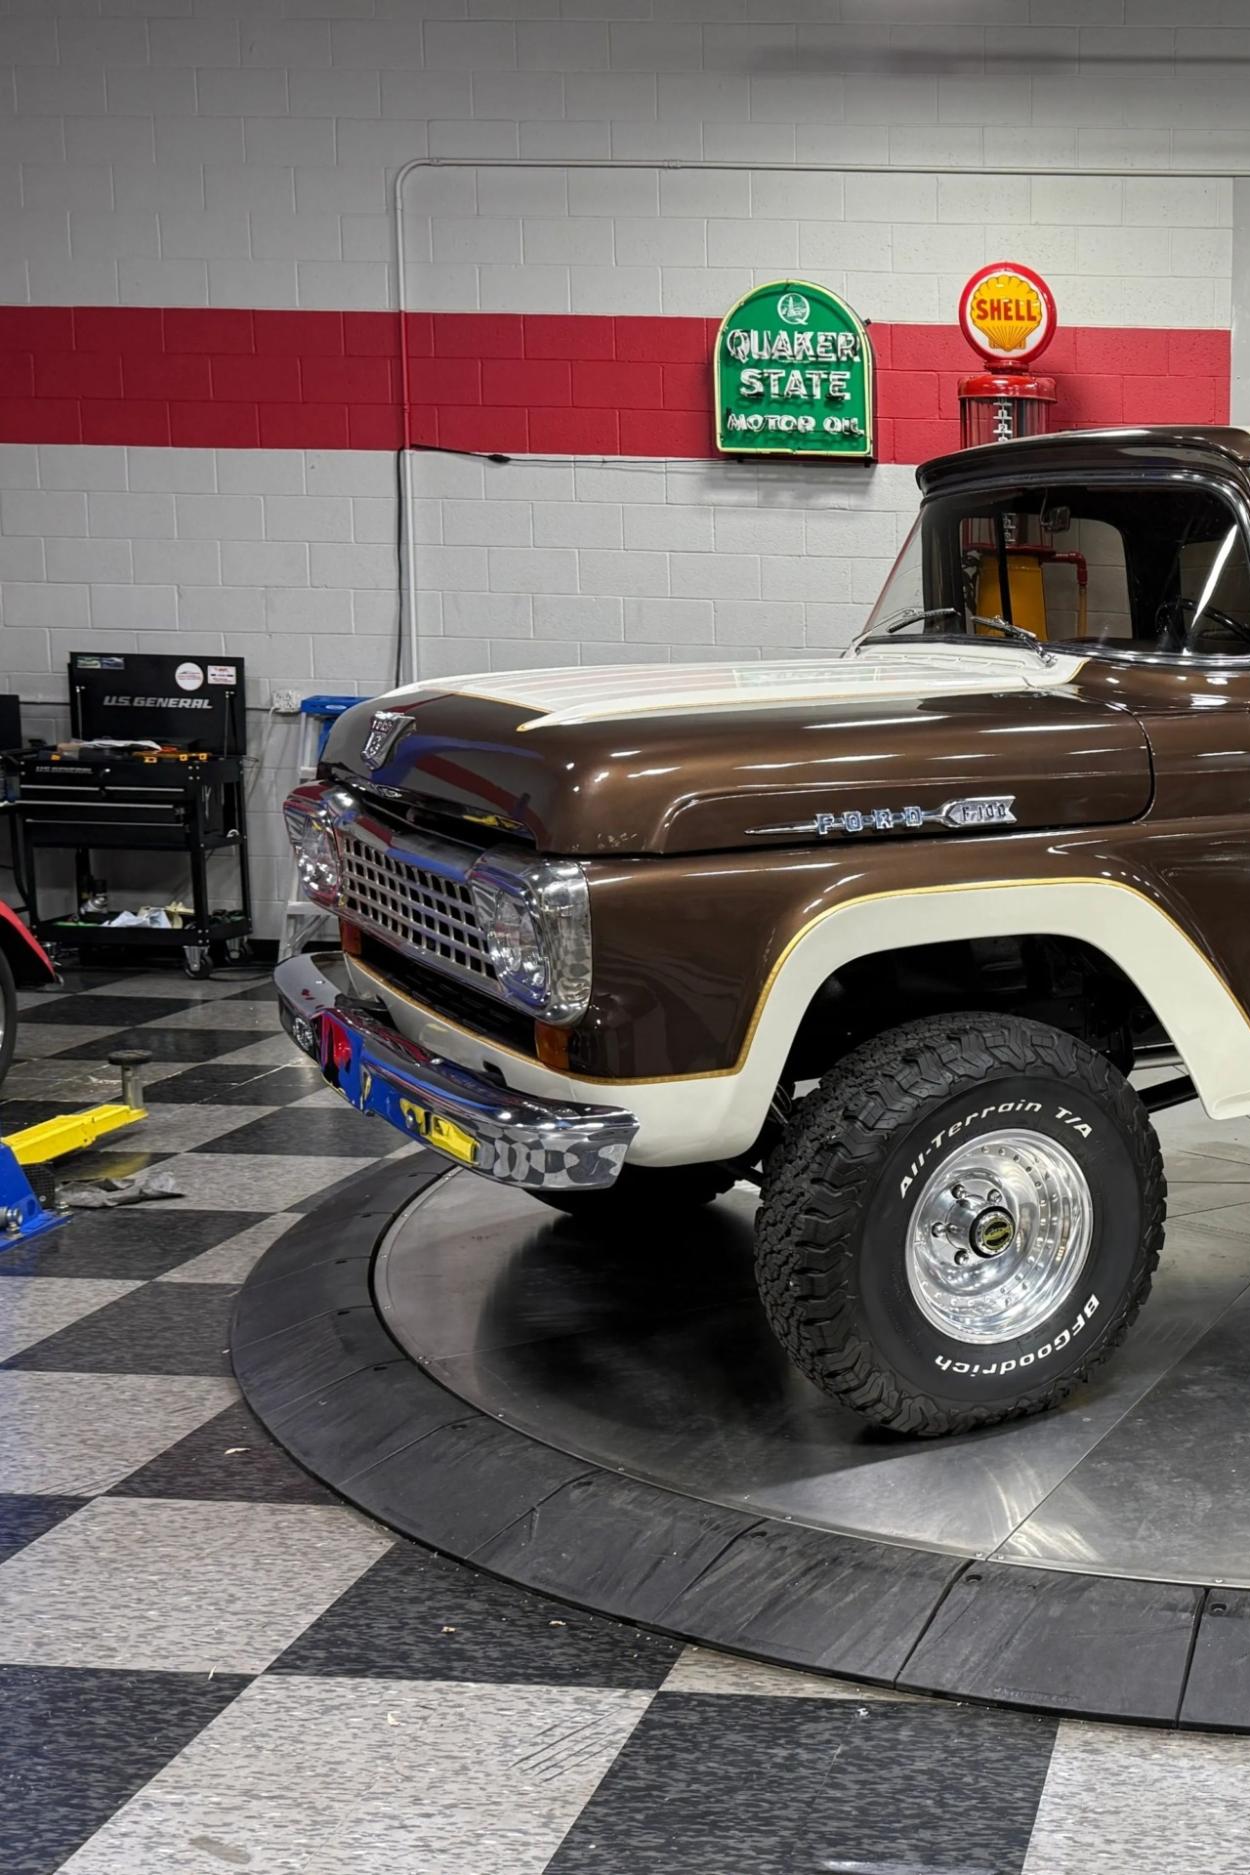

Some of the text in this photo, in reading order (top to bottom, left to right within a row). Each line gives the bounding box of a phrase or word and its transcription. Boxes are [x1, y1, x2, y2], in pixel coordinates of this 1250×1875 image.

[976, 298, 1037, 322] SHELL
[727, 329, 861, 363] QUAKER
[740, 368, 851, 400] STATE
[727, 413, 865, 436] MOTOR OIL
[816, 806, 923, 835] FORD
[901, 1100, 1093, 1199] All-Terrain T/A
[935, 1294, 1100, 1377] BFGoodrich
